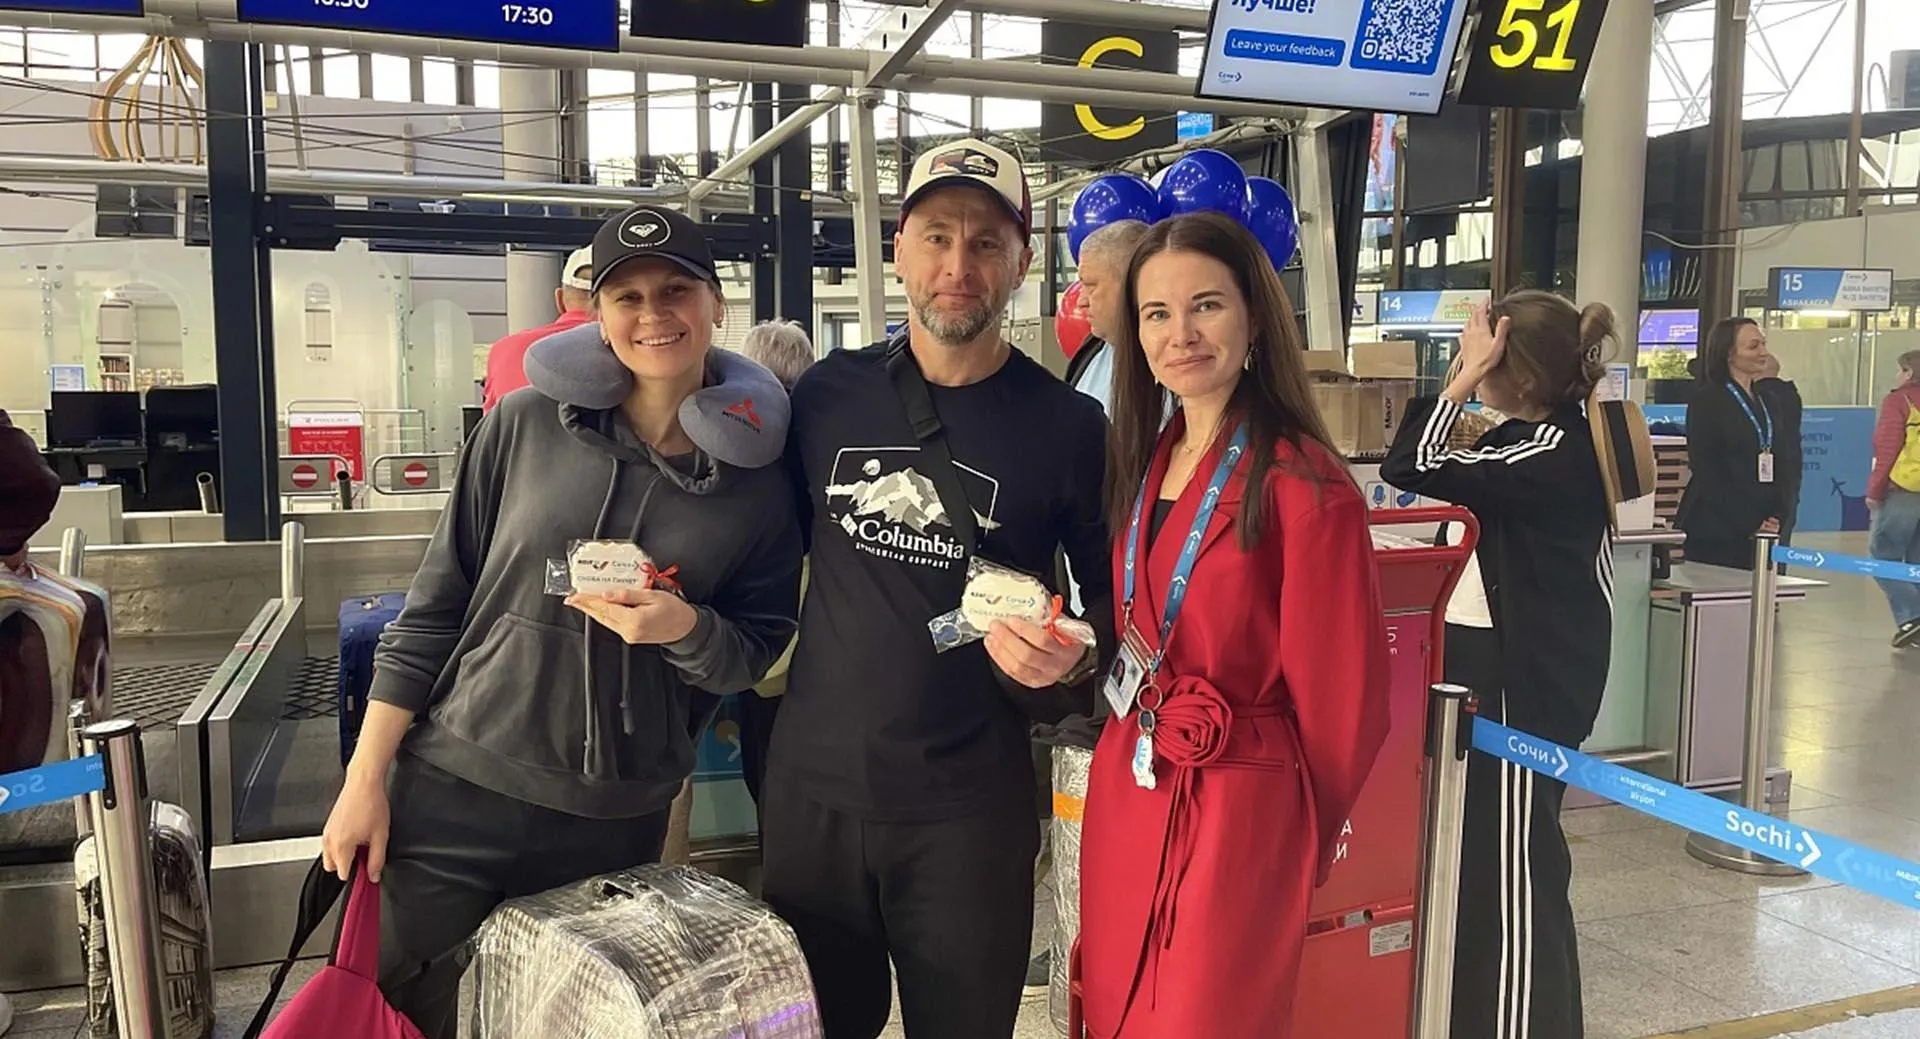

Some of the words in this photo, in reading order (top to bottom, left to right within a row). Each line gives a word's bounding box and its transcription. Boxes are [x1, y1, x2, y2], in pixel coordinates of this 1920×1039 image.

[501, 5, 553, 25] 17:30
[1231, 37, 1262, 51] Leave
[1263, 41, 1288, 54] your
[1288, 42, 1337, 58] feedback
[1489, 0, 1580, 71] 51
[1783, 273, 1803, 292] 15
[1382, 296, 1402, 312] 14
[858, 519, 964, 559] Columbia
[1508, 735, 1548, 764] Сочи
[1726, 810, 1791, 850] Sochi
